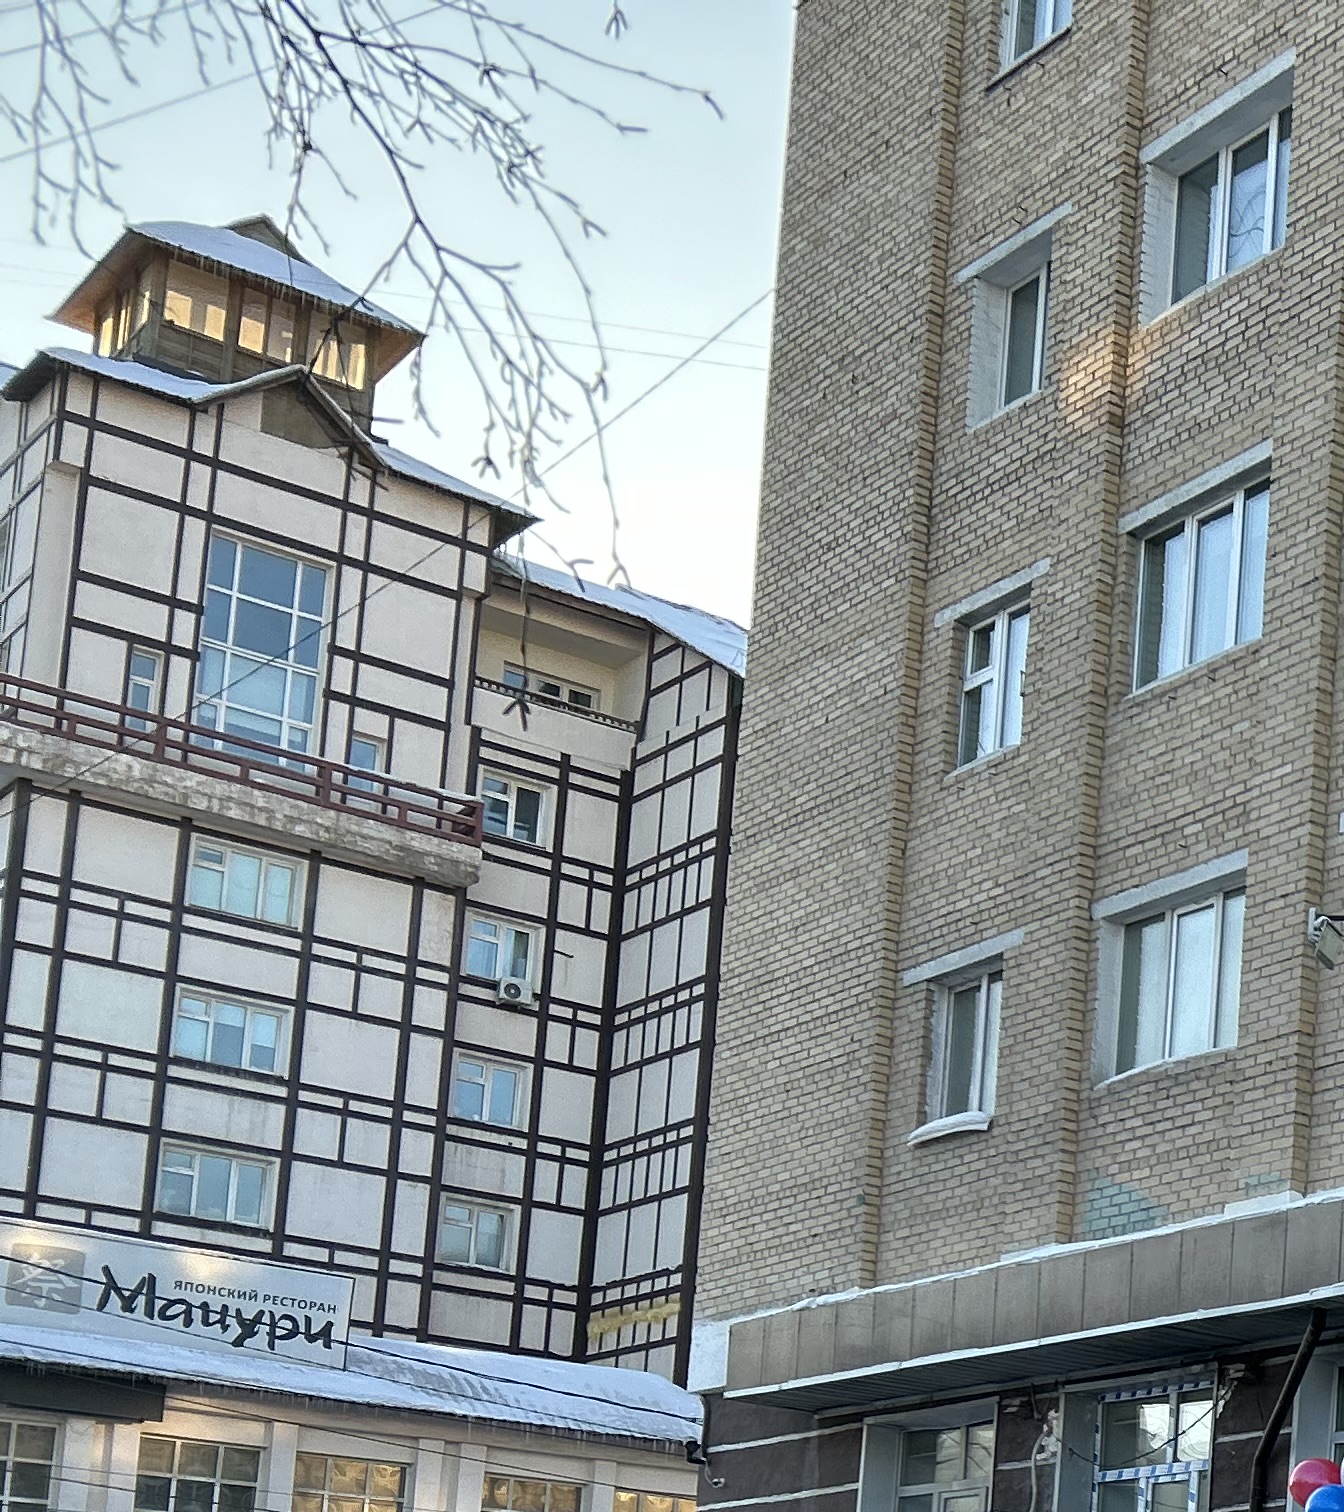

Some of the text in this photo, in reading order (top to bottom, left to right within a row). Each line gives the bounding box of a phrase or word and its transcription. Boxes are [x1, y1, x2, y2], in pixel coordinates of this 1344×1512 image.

[96, 1264, 335, 1350] Мацури
[173, 1279, 337, 1315] ЯПОНСКИЙ РЕСТОРАН
